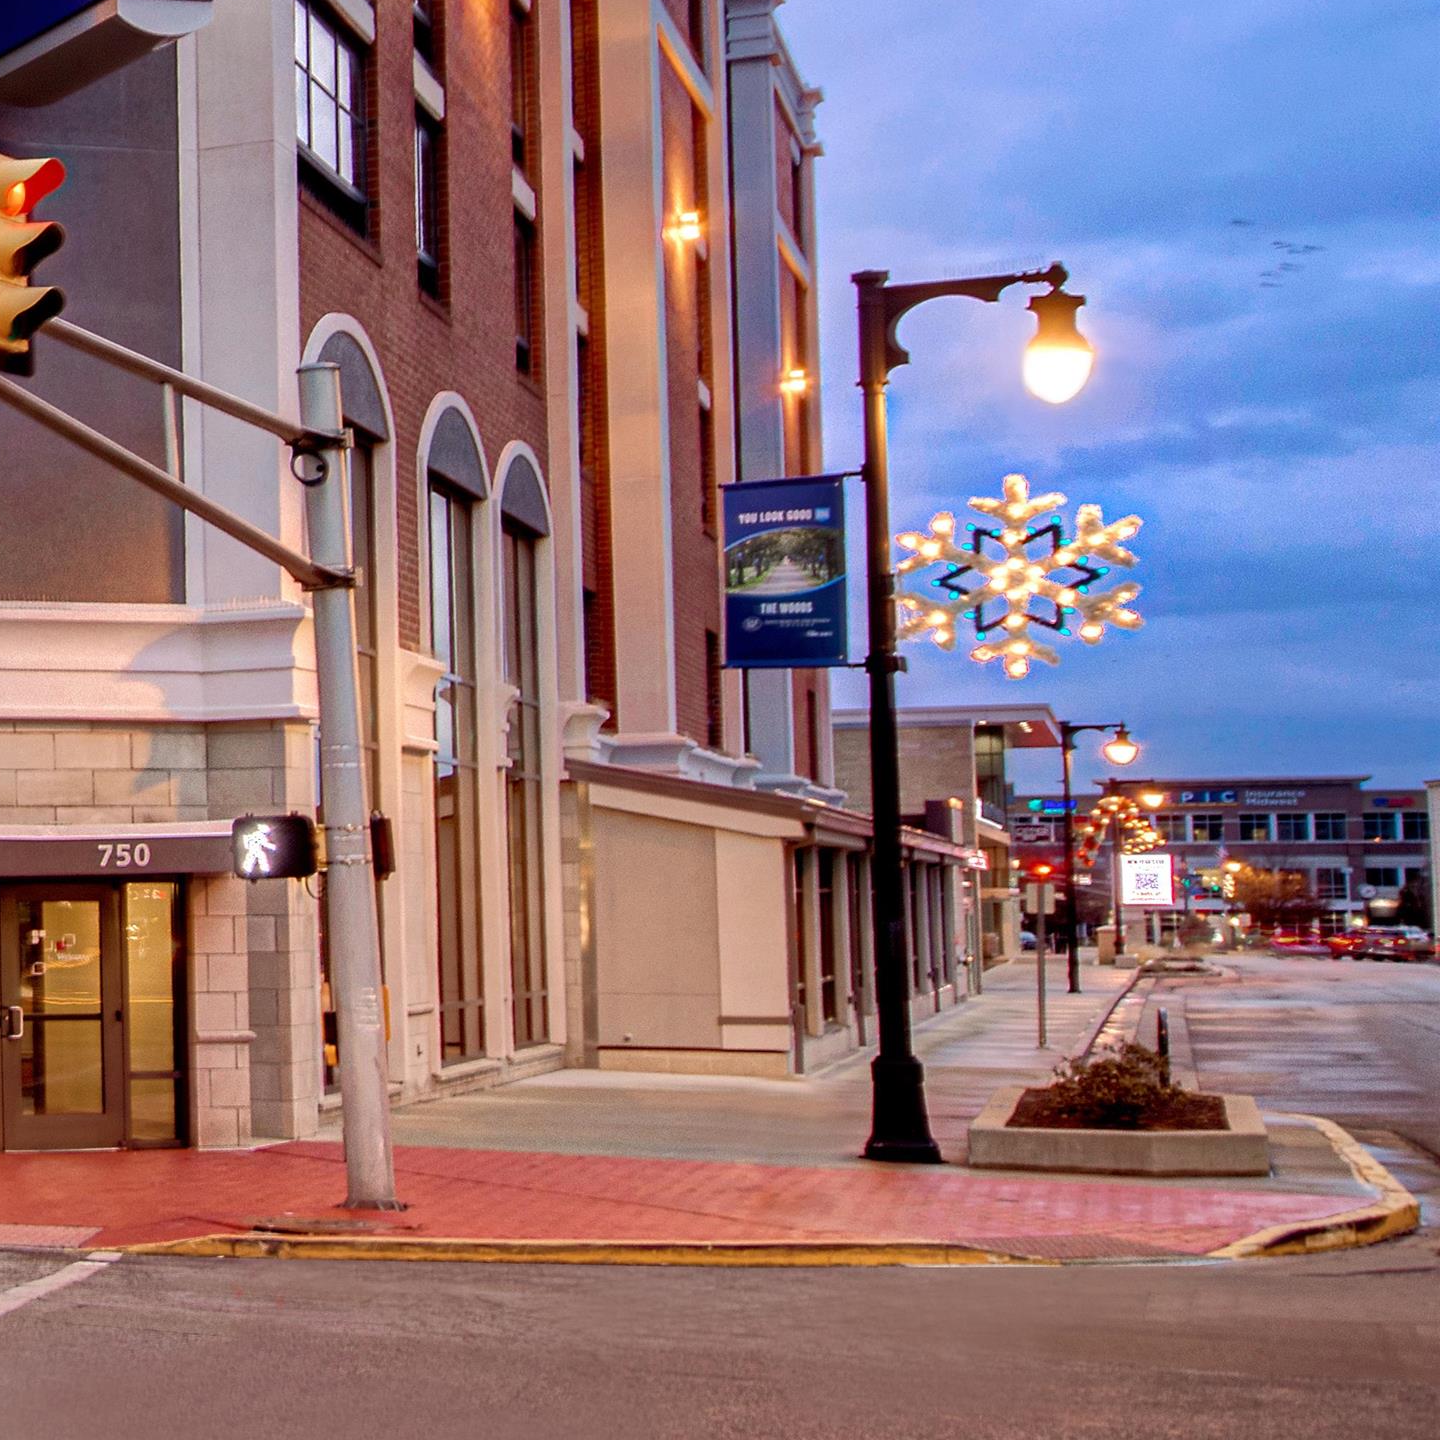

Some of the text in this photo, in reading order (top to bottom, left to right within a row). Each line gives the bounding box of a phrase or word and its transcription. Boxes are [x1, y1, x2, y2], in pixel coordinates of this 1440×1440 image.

[738, 512, 758, 525] YOU
[759, 510, 785, 523] LOOK
[786, 508, 812, 521] GOOD
[760, 602, 778, 614] THE
[97, 843, 151, 867] 750
